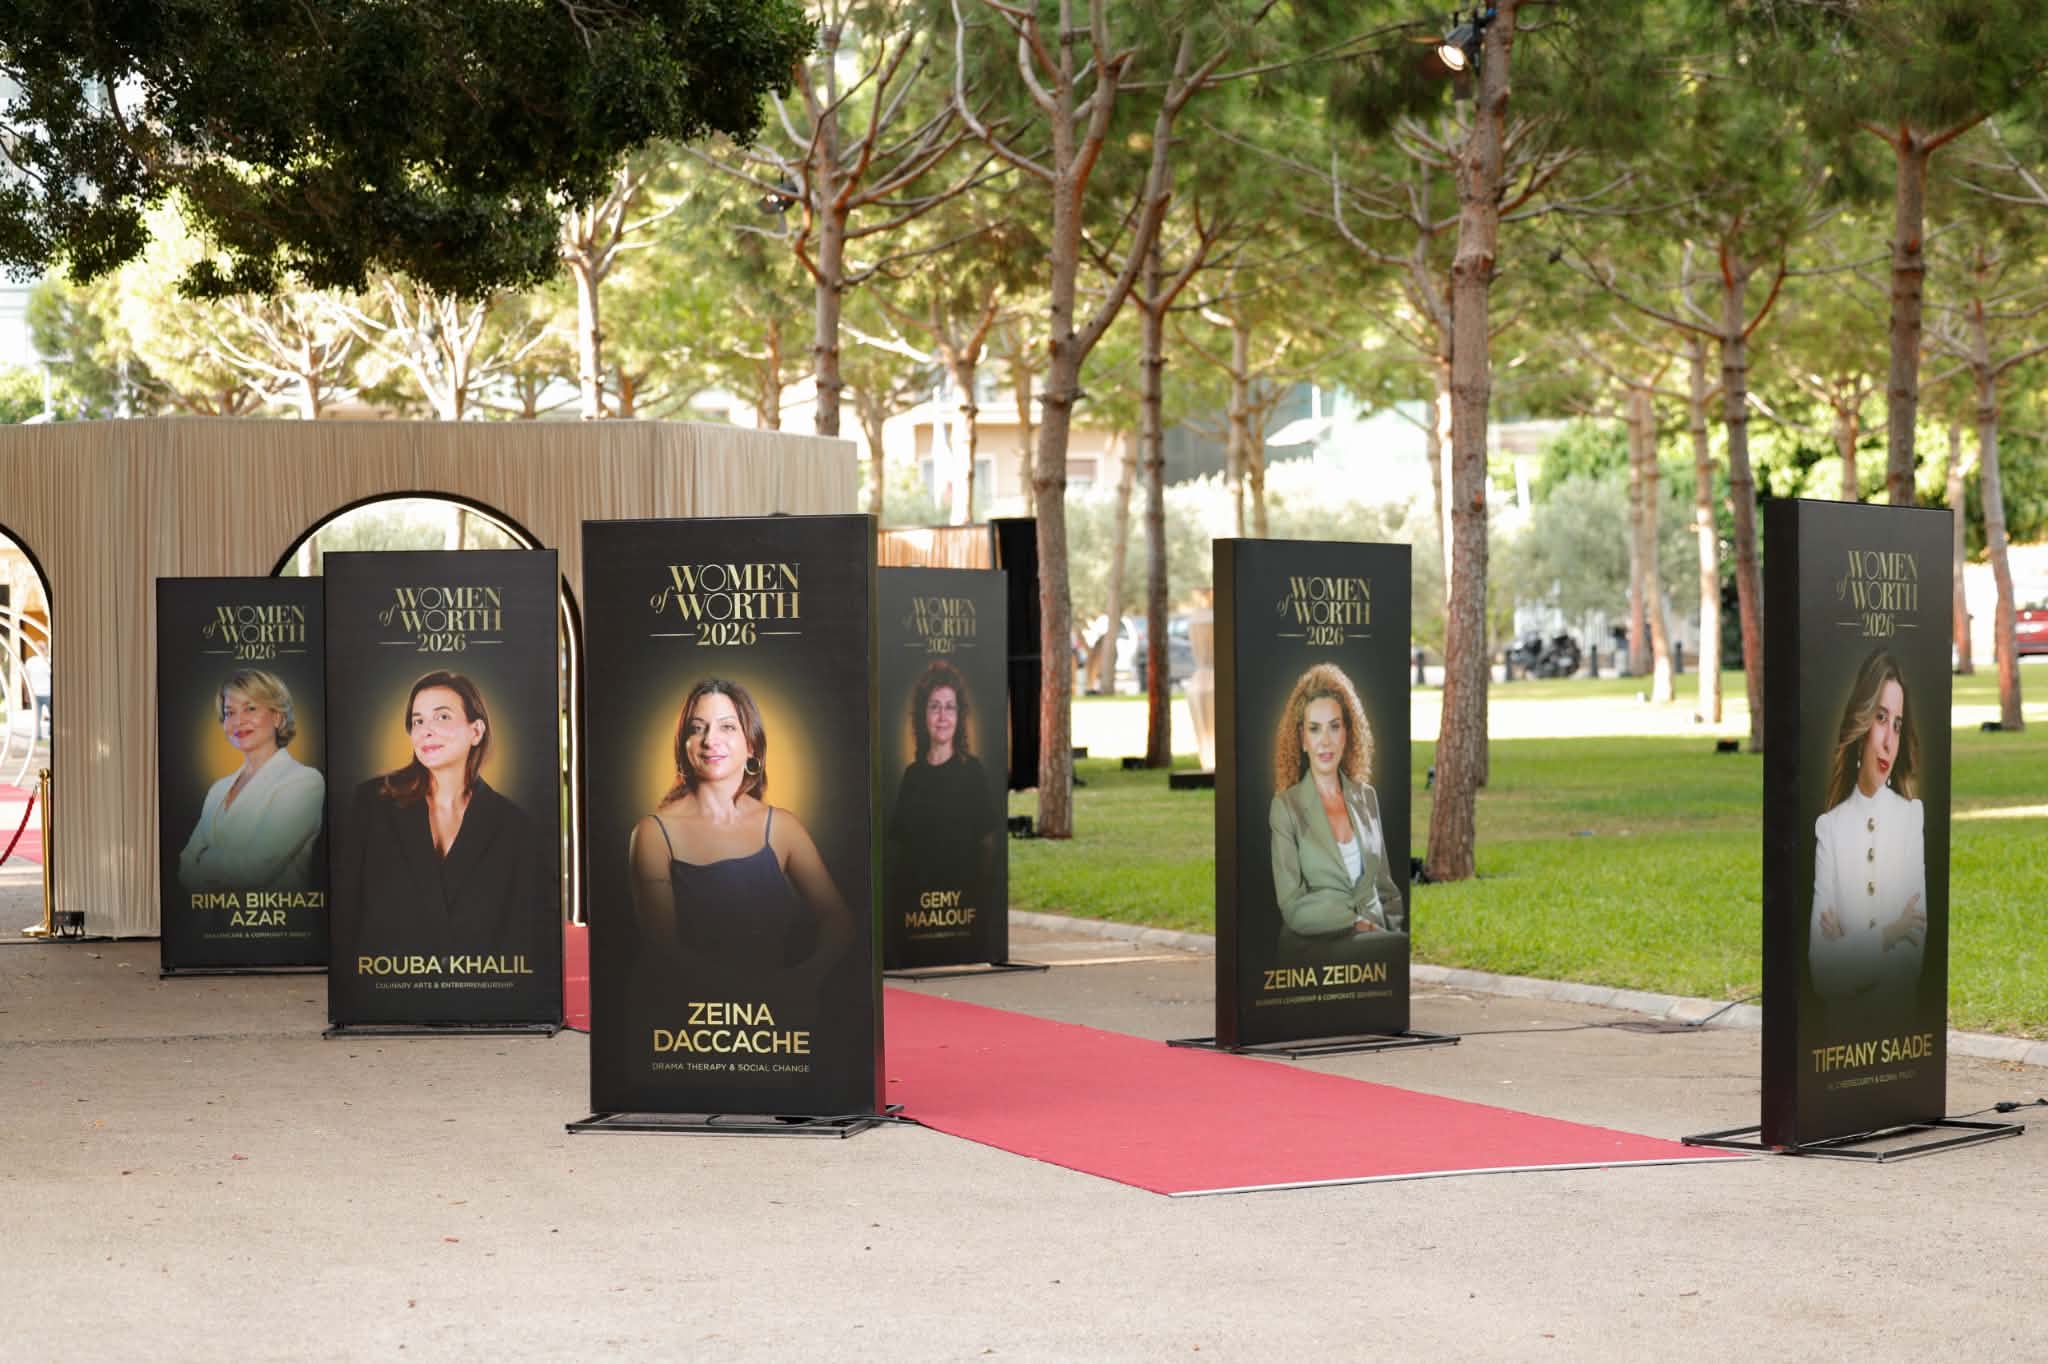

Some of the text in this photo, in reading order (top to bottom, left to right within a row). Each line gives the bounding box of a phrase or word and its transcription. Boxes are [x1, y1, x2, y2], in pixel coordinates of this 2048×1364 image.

[1848, 550, 1919, 580] WOMEN
[667, 563, 801, 593] WOMEN
[1290, 576, 1371, 601] WOMEN
[395, 586, 504, 609] WOMEN
[650, 586, 801, 621] of WORTH
[912, 596, 977, 616] WOMEN
[1851, 580, 1919, 610] WORTH
[216, 605, 305, 625] WOMEN
[378, 603, 504, 632] of WORTH
[1276, 593, 1371, 625] of WORTH
[202, 620, 305, 643] of WORTH
[696, 622, 757, 646] 2026
[915, 616, 977, 636] WORTH
[1306, 625, 1344, 646] 2026
[1862, 612, 1895, 639] 2026
[235, 643, 276, 660] 2026
[416, 633, 466, 652] 2026
[191, 891, 324, 909] RIMA BIKHAZI
[920, 890, 962, 909] GEMY
[230, 910, 287, 926] AZAR
[904, 908, 977, 928] MAALOUF
[358, 955, 534, 975] ROUBA KHALIL
[1263, 962, 1387, 990] ZEINA ZEIDAN
[376, 982, 411, 990] CULINARY
[414, 981, 433, 989] ARTS
[434, 981, 439, 989] &
[687, 1002, 776, 1026] ZEINA
[653, 1029, 811, 1054] DACCACHE
[1812, 1033, 1933, 1072] TIFFANY SAADE
[652, 1062, 810, 1073] DRAMA THERAPY & SOCIAL CHANGE
